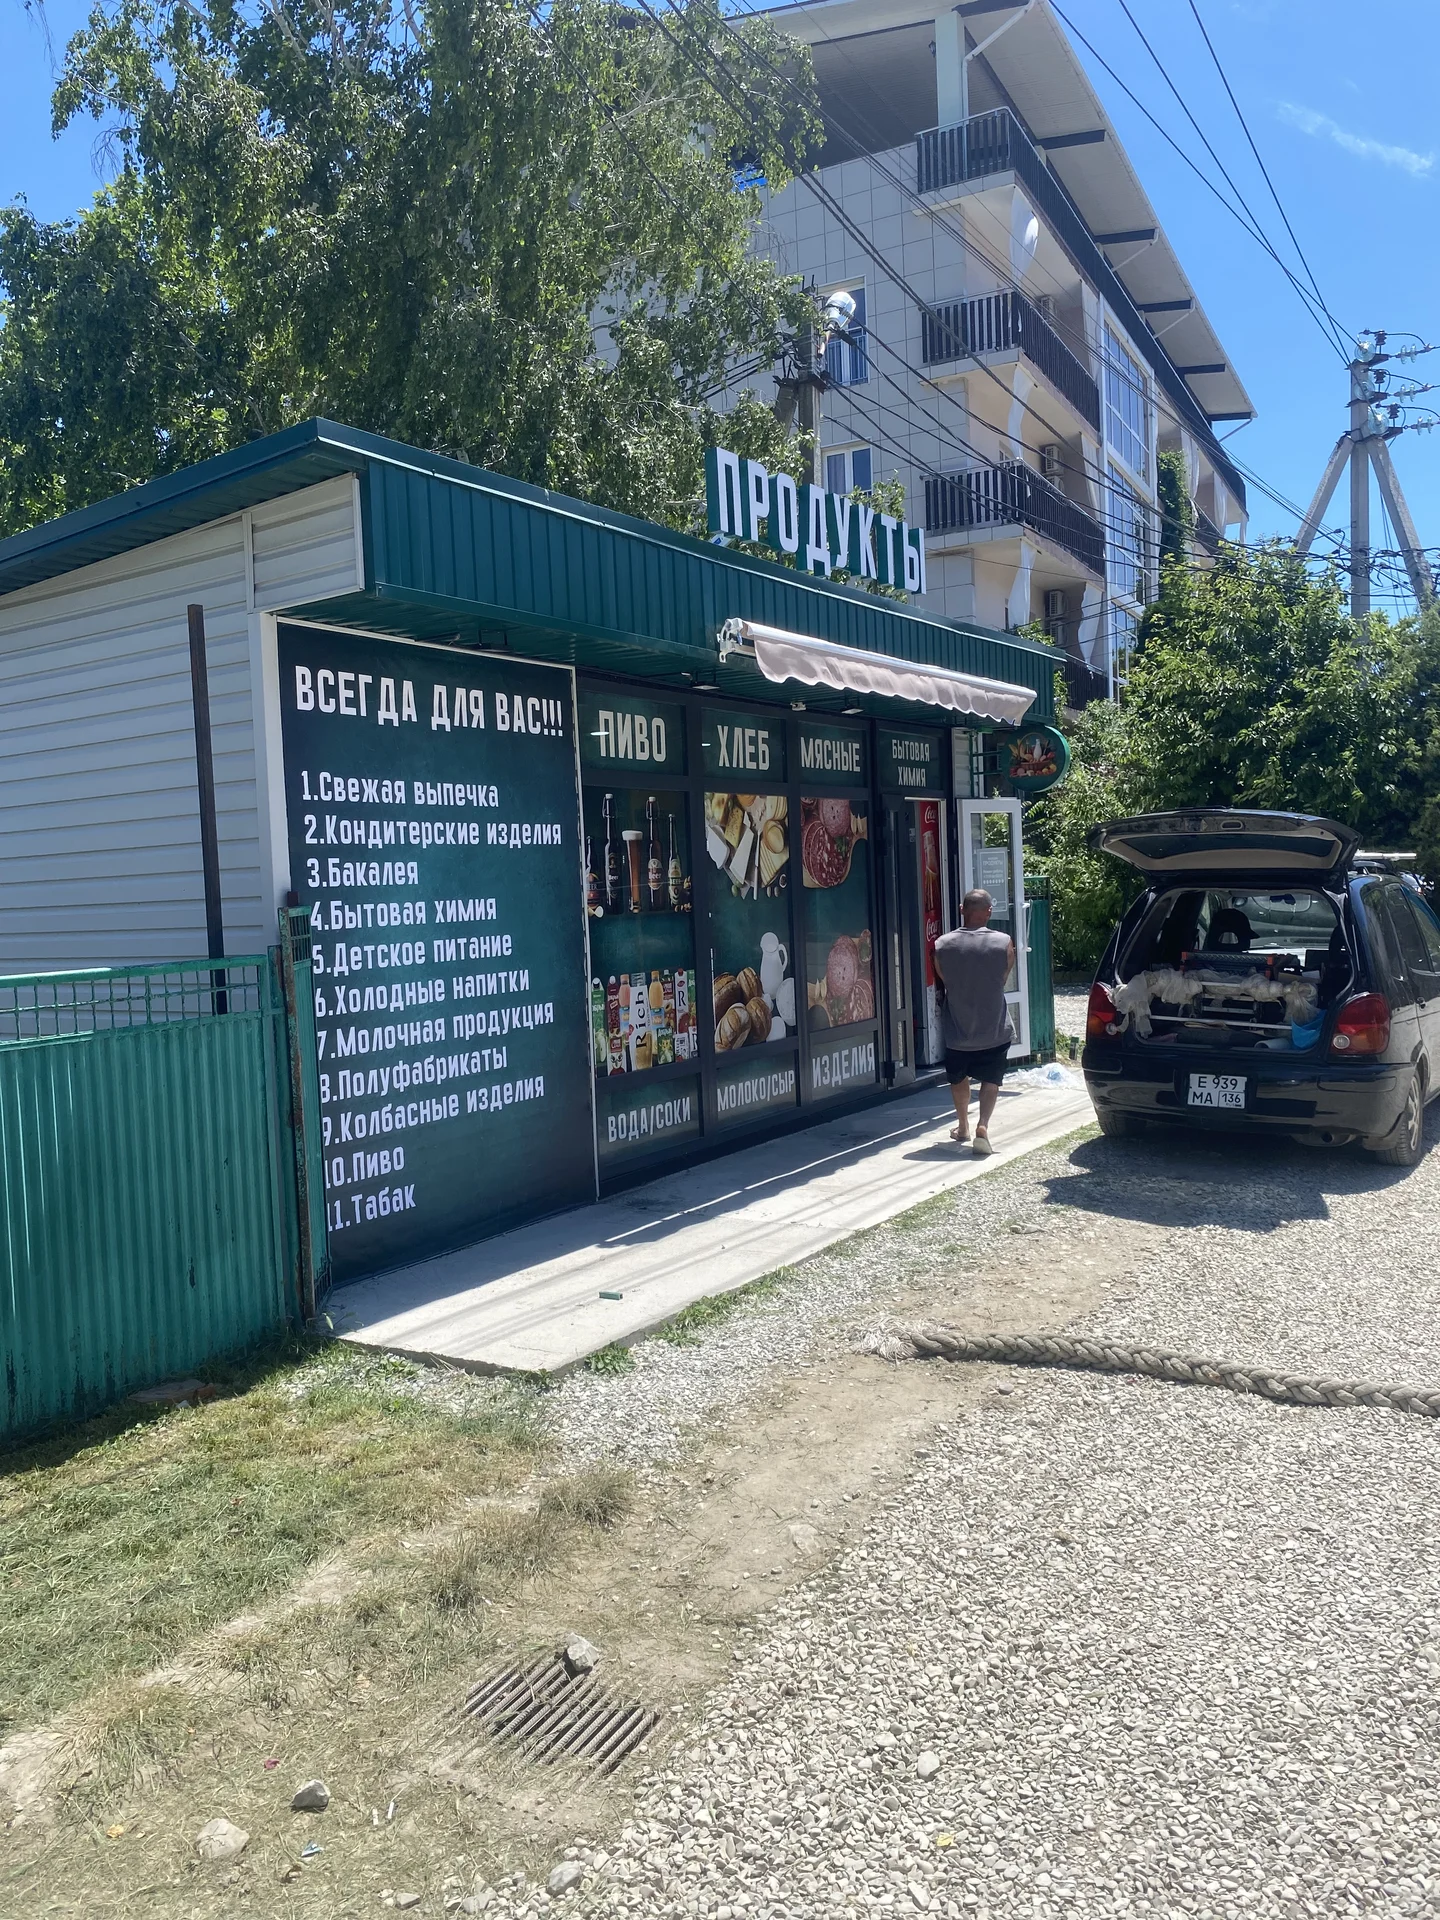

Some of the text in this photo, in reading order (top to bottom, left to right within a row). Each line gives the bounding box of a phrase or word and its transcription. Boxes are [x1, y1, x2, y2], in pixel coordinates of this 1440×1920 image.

[716, 446, 927, 595] ПРОДУКТЫ
[295, 665, 563, 737] ВСЕГДА ДЛЯ ВАС!!!
[598, 709, 667, 763] ПИВО
[716, 724, 770, 772] ХЛЕБ
[800, 736, 861, 773] МЯСНЫЕ
[892, 738, 930, 763] БЫТОВАЯ
[301, 770, 499, 807] 1.Свежая выпечка
[897, 765, 926, 788] ХИМИЯ
[304, 814, 562, 849] 2.Кондитерские изделия
[306, 857, 419, 888] 3.Бакалея
[310, 898, 497, 931] 4.Бытовая химия
[312, 933, 512, 976] 5.Детское питание
[315, 969, 530, 1018] 6.Холодные напитки
[317, 1002, 554, 1061] 7.Молочная продукция
[635, 991, 647, 1049] Rich
[320, 1045, 508, 1104] 8.Полуфабрикаты
[812, 1042, 875, 1089] ИЗДЕЛИЯ
[1212, 1076, 1238, 1090] 939
[322, 1075, 545, 1147] 9.Колбасные изделия
[716, 1068, 796, 1112] МОЛОКО/СЫР
[1221, 1093, 1241, 1103] 136
[607, 1095, 691, 1143] ВОДА/СОКИ
